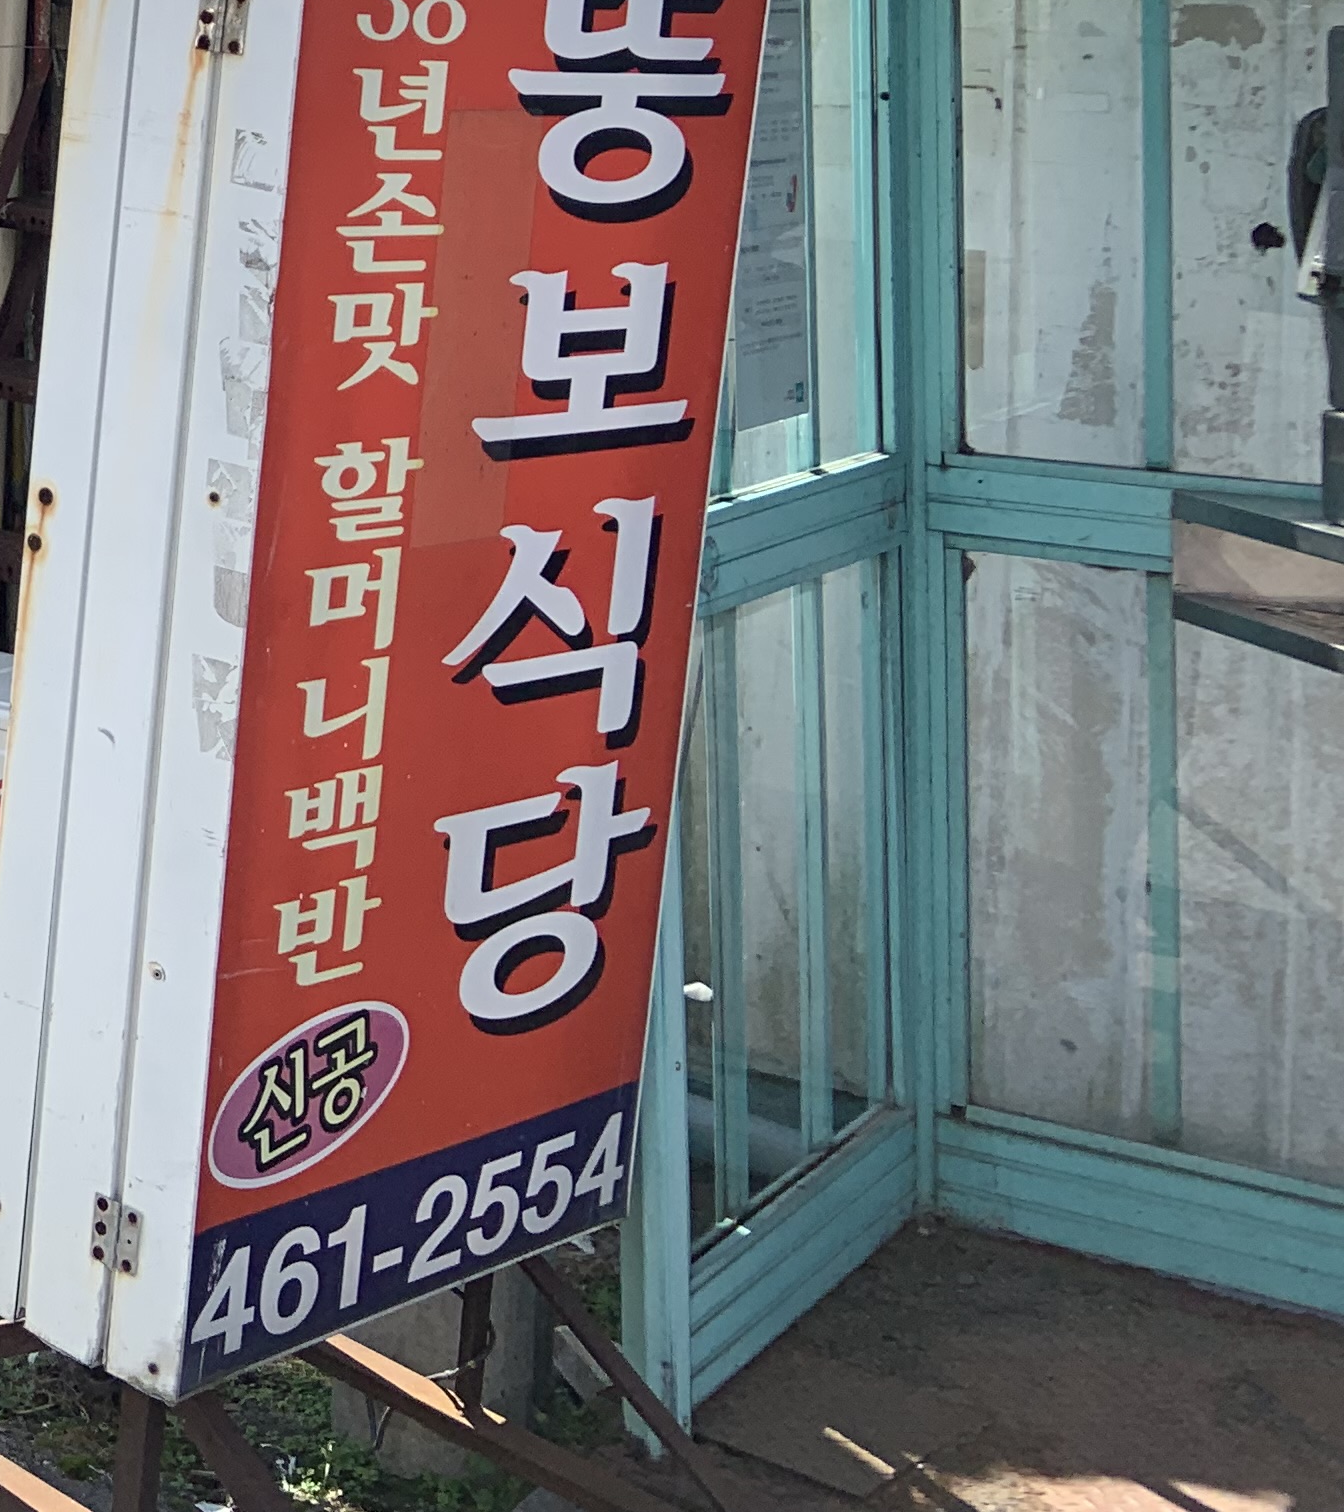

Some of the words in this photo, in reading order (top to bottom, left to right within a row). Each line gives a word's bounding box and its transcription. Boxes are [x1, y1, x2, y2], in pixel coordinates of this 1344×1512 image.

[273, 436, 425, 988] 할머니백반
[239, 1011, 379, 1166] 신공
[191, 1110, 626, 1357] 461-2554
